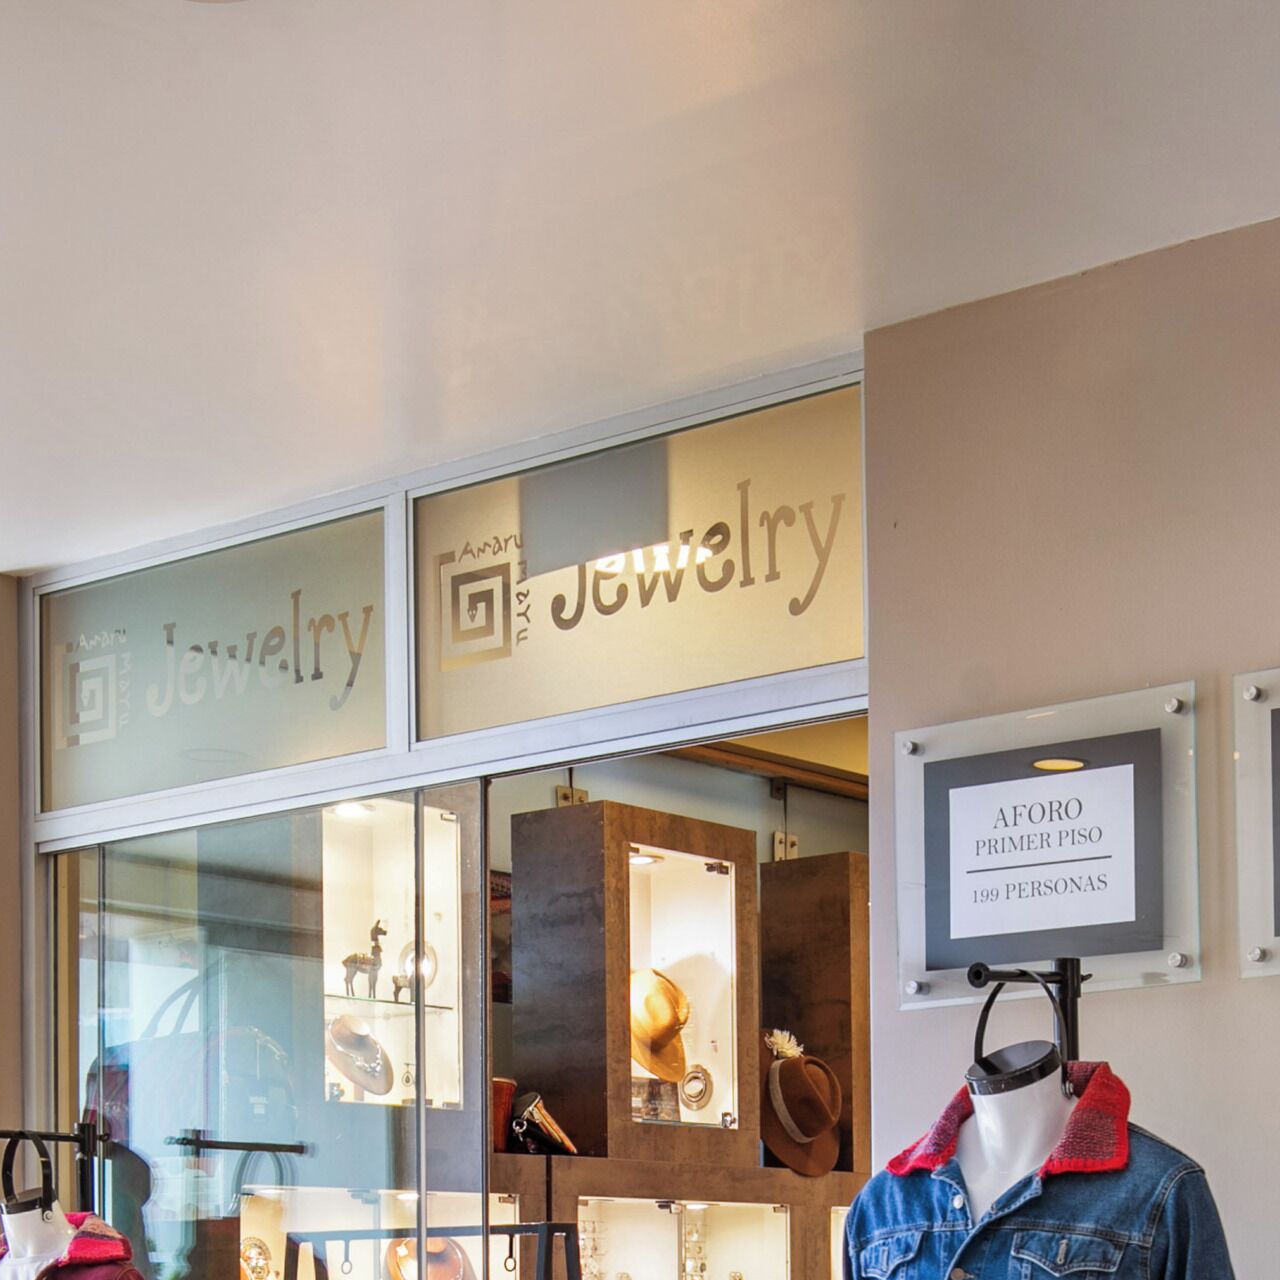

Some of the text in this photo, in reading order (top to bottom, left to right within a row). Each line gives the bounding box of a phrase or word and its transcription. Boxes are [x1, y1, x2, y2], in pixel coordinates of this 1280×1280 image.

[458, 532, 524, 563] Amaru
[550, 478, 846, 631] Jewelry
[145, 588, 374, 718] Jewelry
[993, 797, 1083, 829] AFORO
[975, 826, 1103, 857] PRIMER PISO
[972, 873, 1108, 904] 199 PERSONAS
